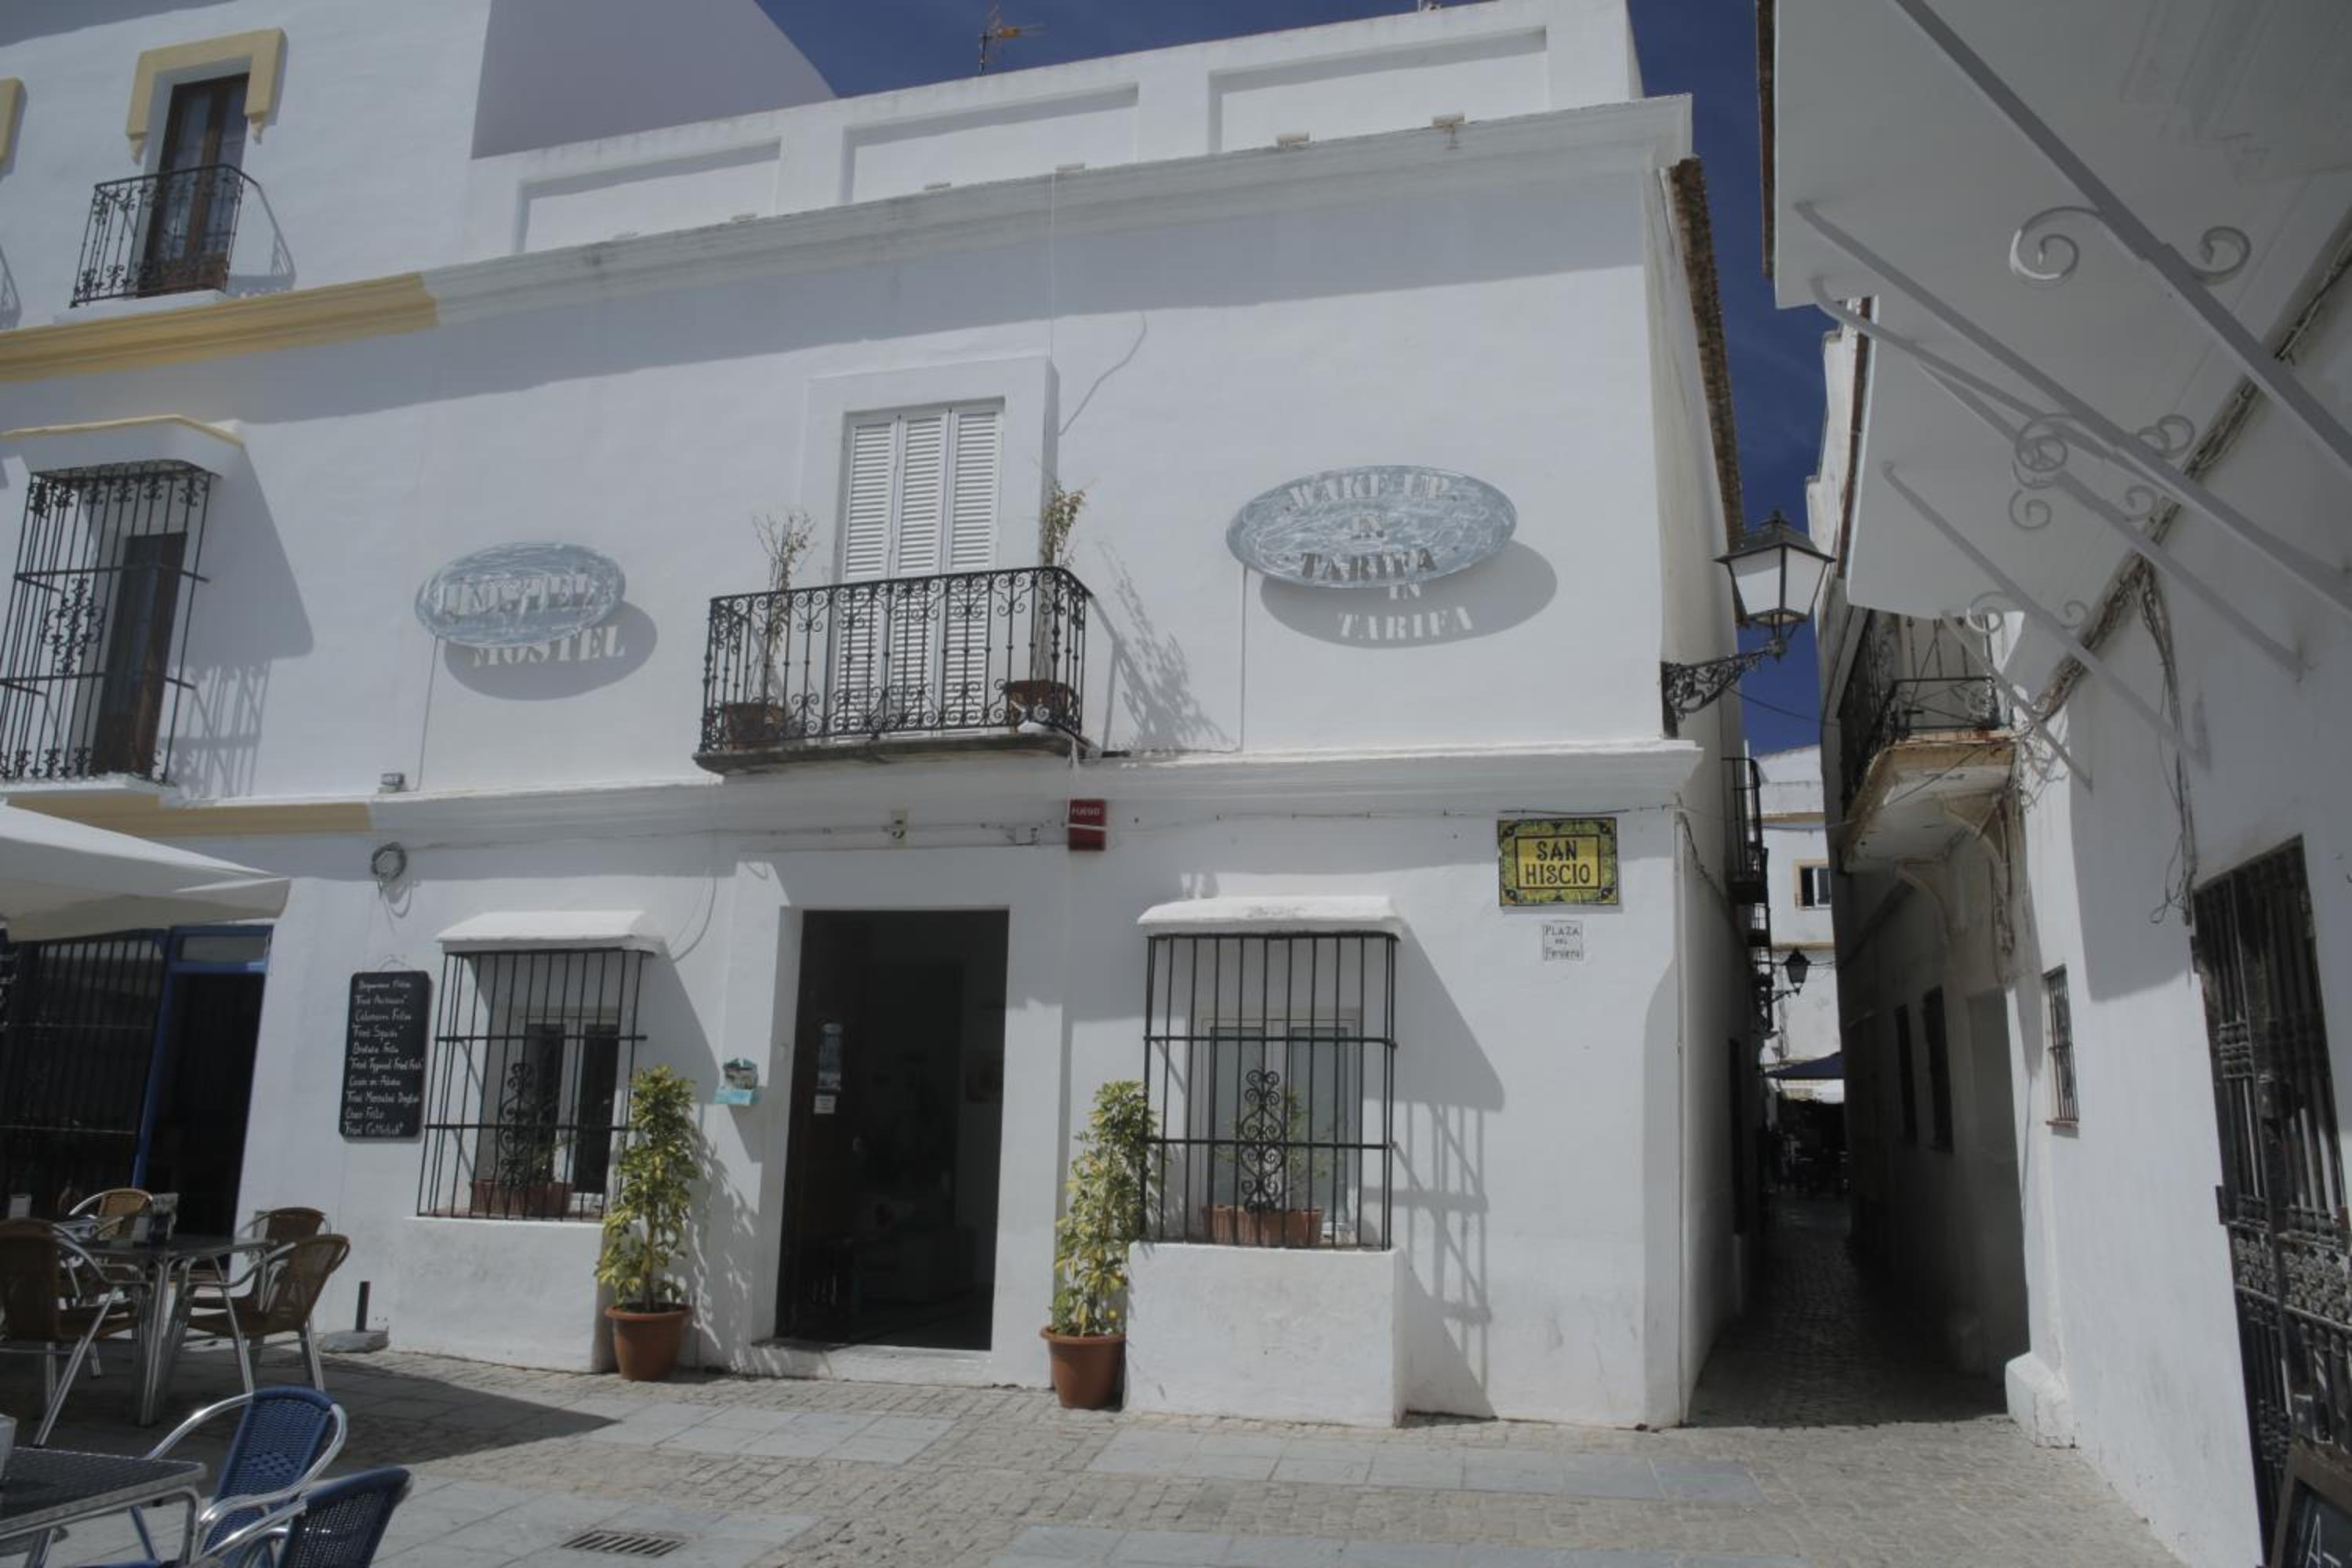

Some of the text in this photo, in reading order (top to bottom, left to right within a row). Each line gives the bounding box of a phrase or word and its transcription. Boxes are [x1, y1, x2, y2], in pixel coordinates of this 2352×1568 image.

[1288, 474, 1450, 510] WAKE UP
[1350, 514, 1386, 540] IN
[1300, 547, 1437, 581] TARIFA
[1536, 840, 1577, 862] SAN
[1525, 863, 1591, 885] HISCIO
[1545, 924, 1581, 936] PLAZA
